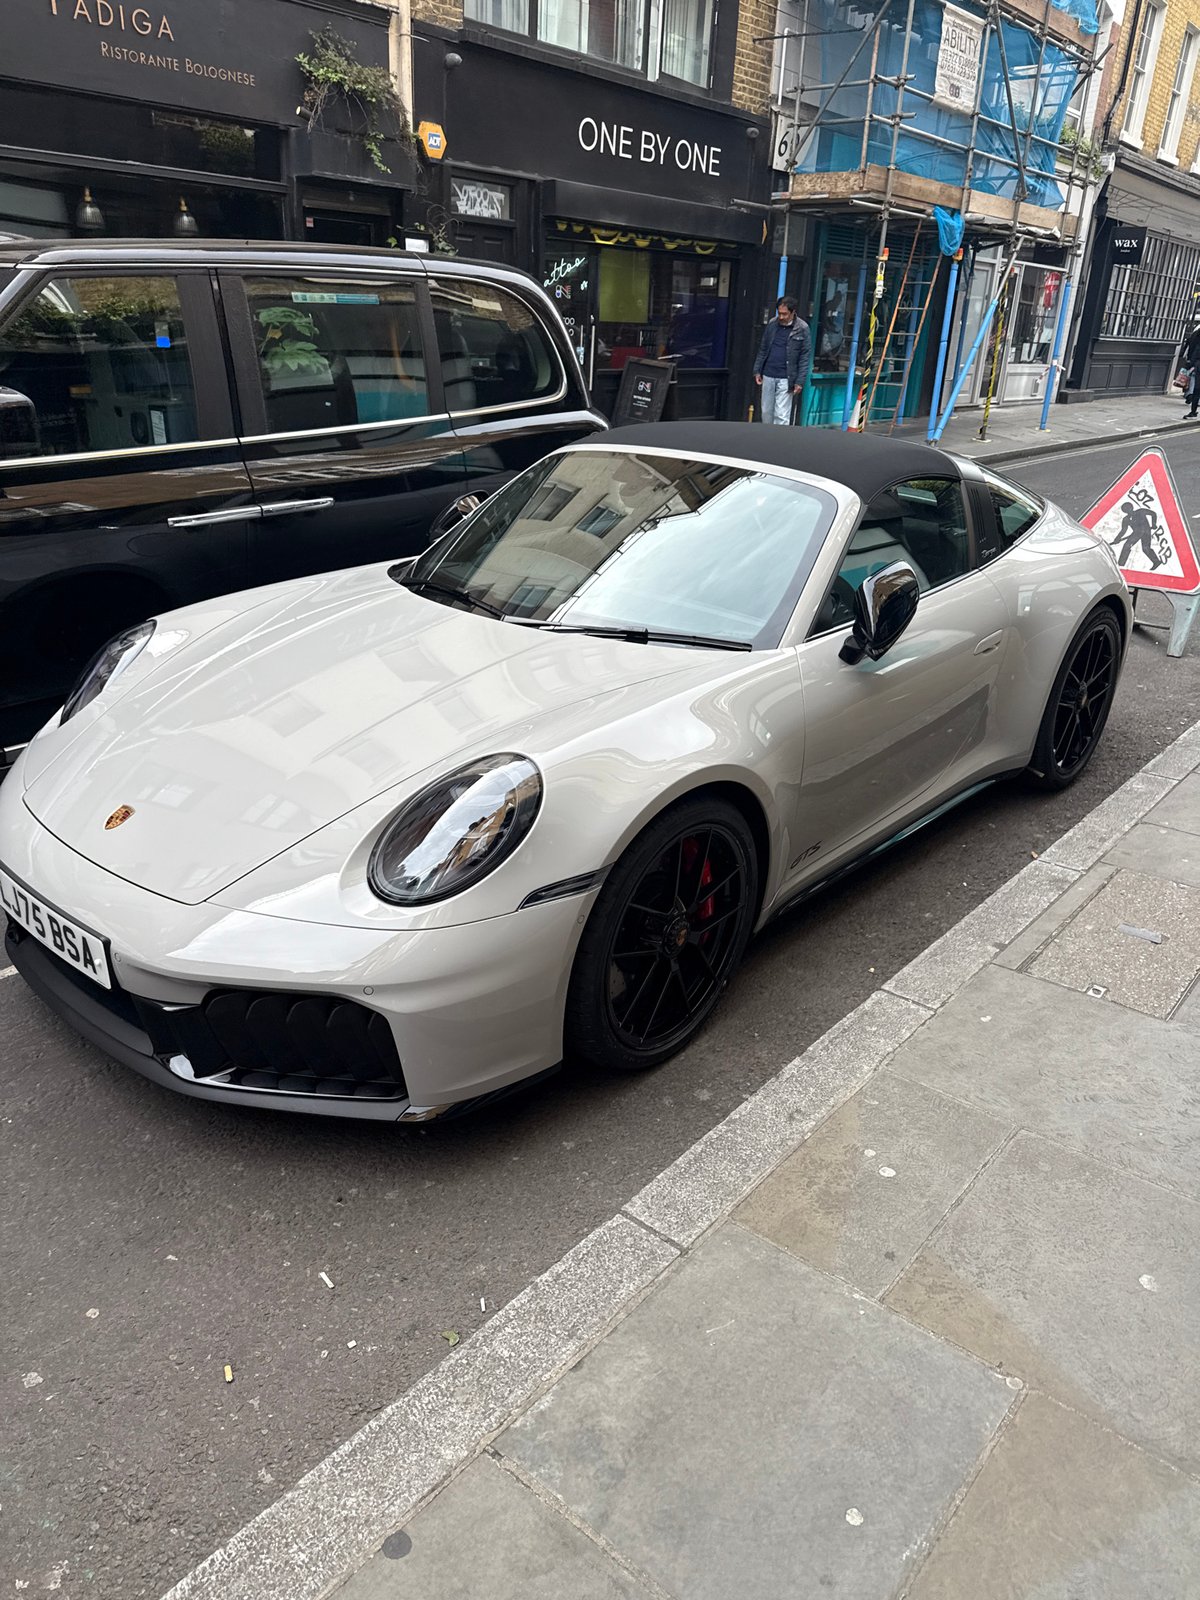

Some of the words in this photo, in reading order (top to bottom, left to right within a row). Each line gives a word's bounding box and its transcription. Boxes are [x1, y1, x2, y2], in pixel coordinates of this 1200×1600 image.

[943, 26, 979, 58] ABILITY
[100, 41, 180, 71] RISTORANTE
[185, 58, 256, 87] BOLOGNESE
[578, 117, 634, 159] ONE
[640, 130, 671, 165] BY
[675, 139, 722, 176] ONE
[1114, 239, 1138, 248] wax
[543, 257, 586, 288] attoo
[790, 839, 824, 870] GTS
[0, 879, 46, 938] LJ75
[47, 912, 98, 975] BSA
